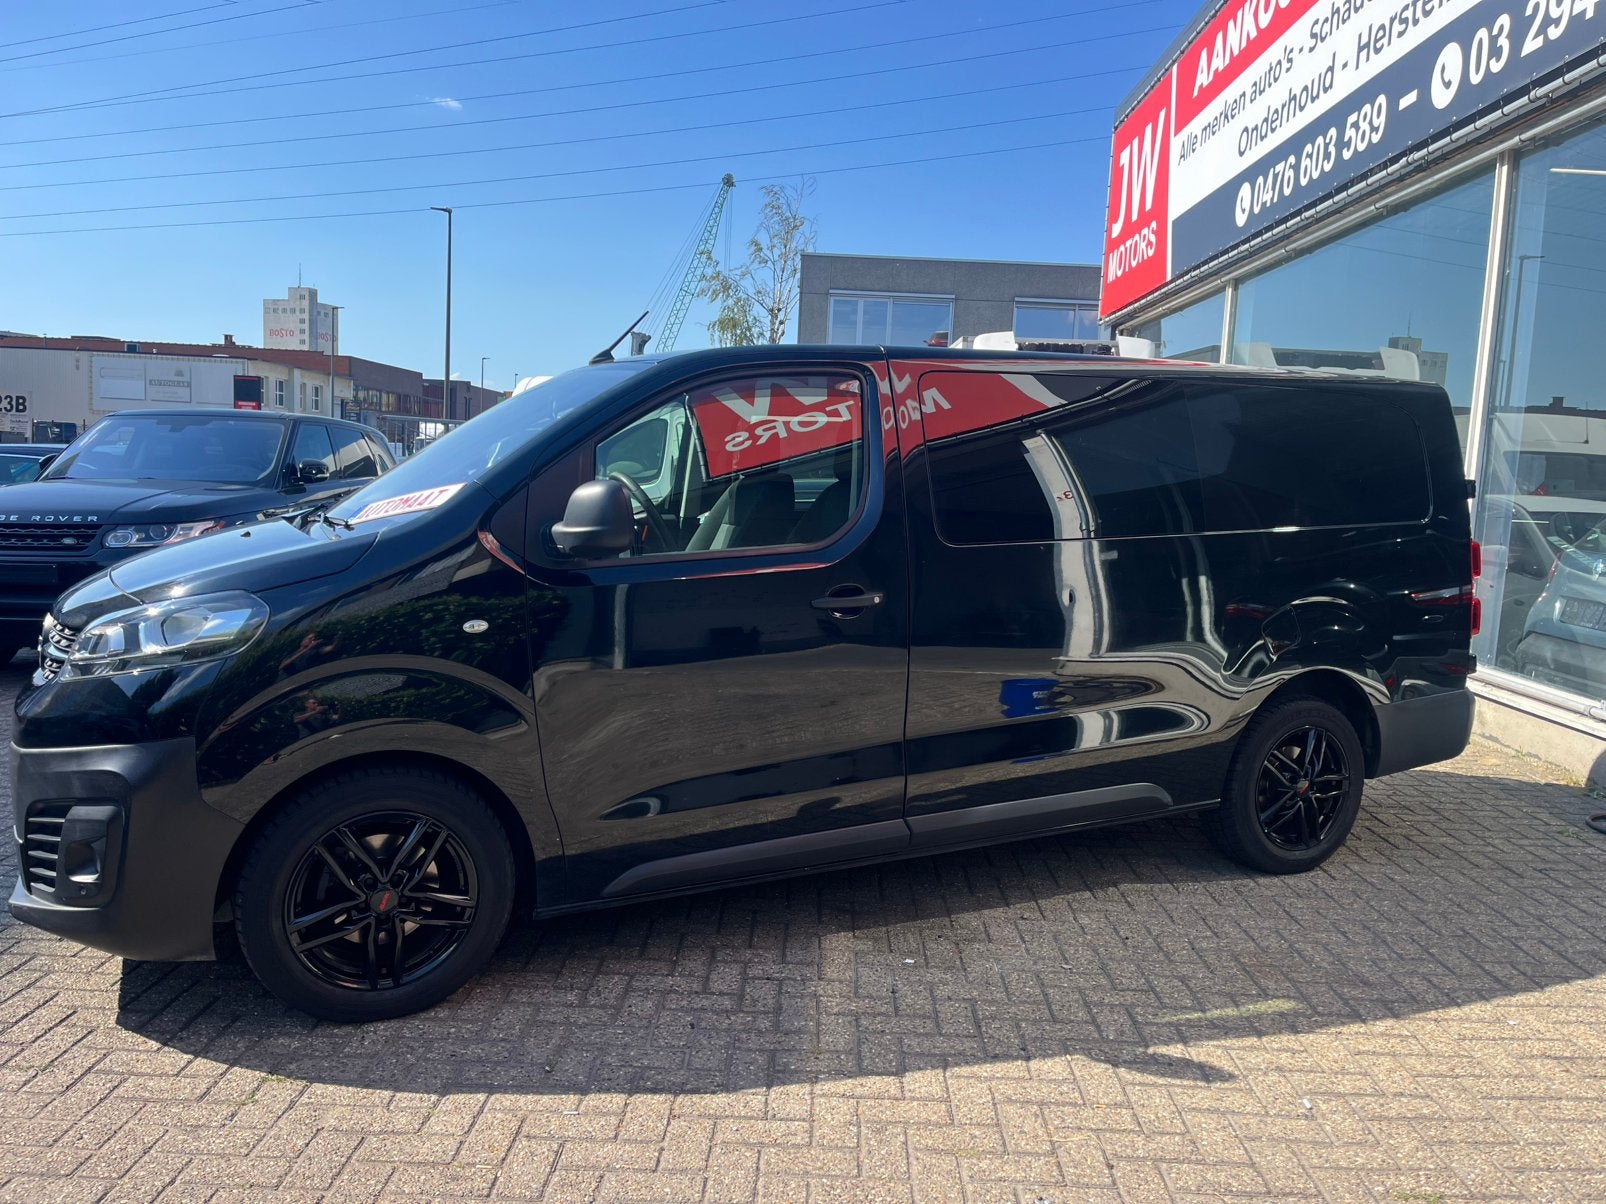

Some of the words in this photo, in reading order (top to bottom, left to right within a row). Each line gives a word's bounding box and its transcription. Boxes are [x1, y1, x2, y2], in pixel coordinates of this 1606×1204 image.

[1178, 132, 1198, 166] Alle
[1200, 90, 1246, 147] merken
[1250, 45, 1294, 104] auto's
[1192, 0, 1291, 99] AANKO
[1238, 51, 1336, 158] Onderhoud
[1355, 0, 1450, 71] Herste
[1111, 107, 1166, 239] JW
[1253, 154, 1296, 215] 0476
[1300, 127, 1337, 187] 603
[1342, 93, 1387, 161] 589
[1469, 13, 1511, 85] 03
[1107, 220, 1157, 284] MOTORS
[356, 488, 450, 520] AUTOMAAT
